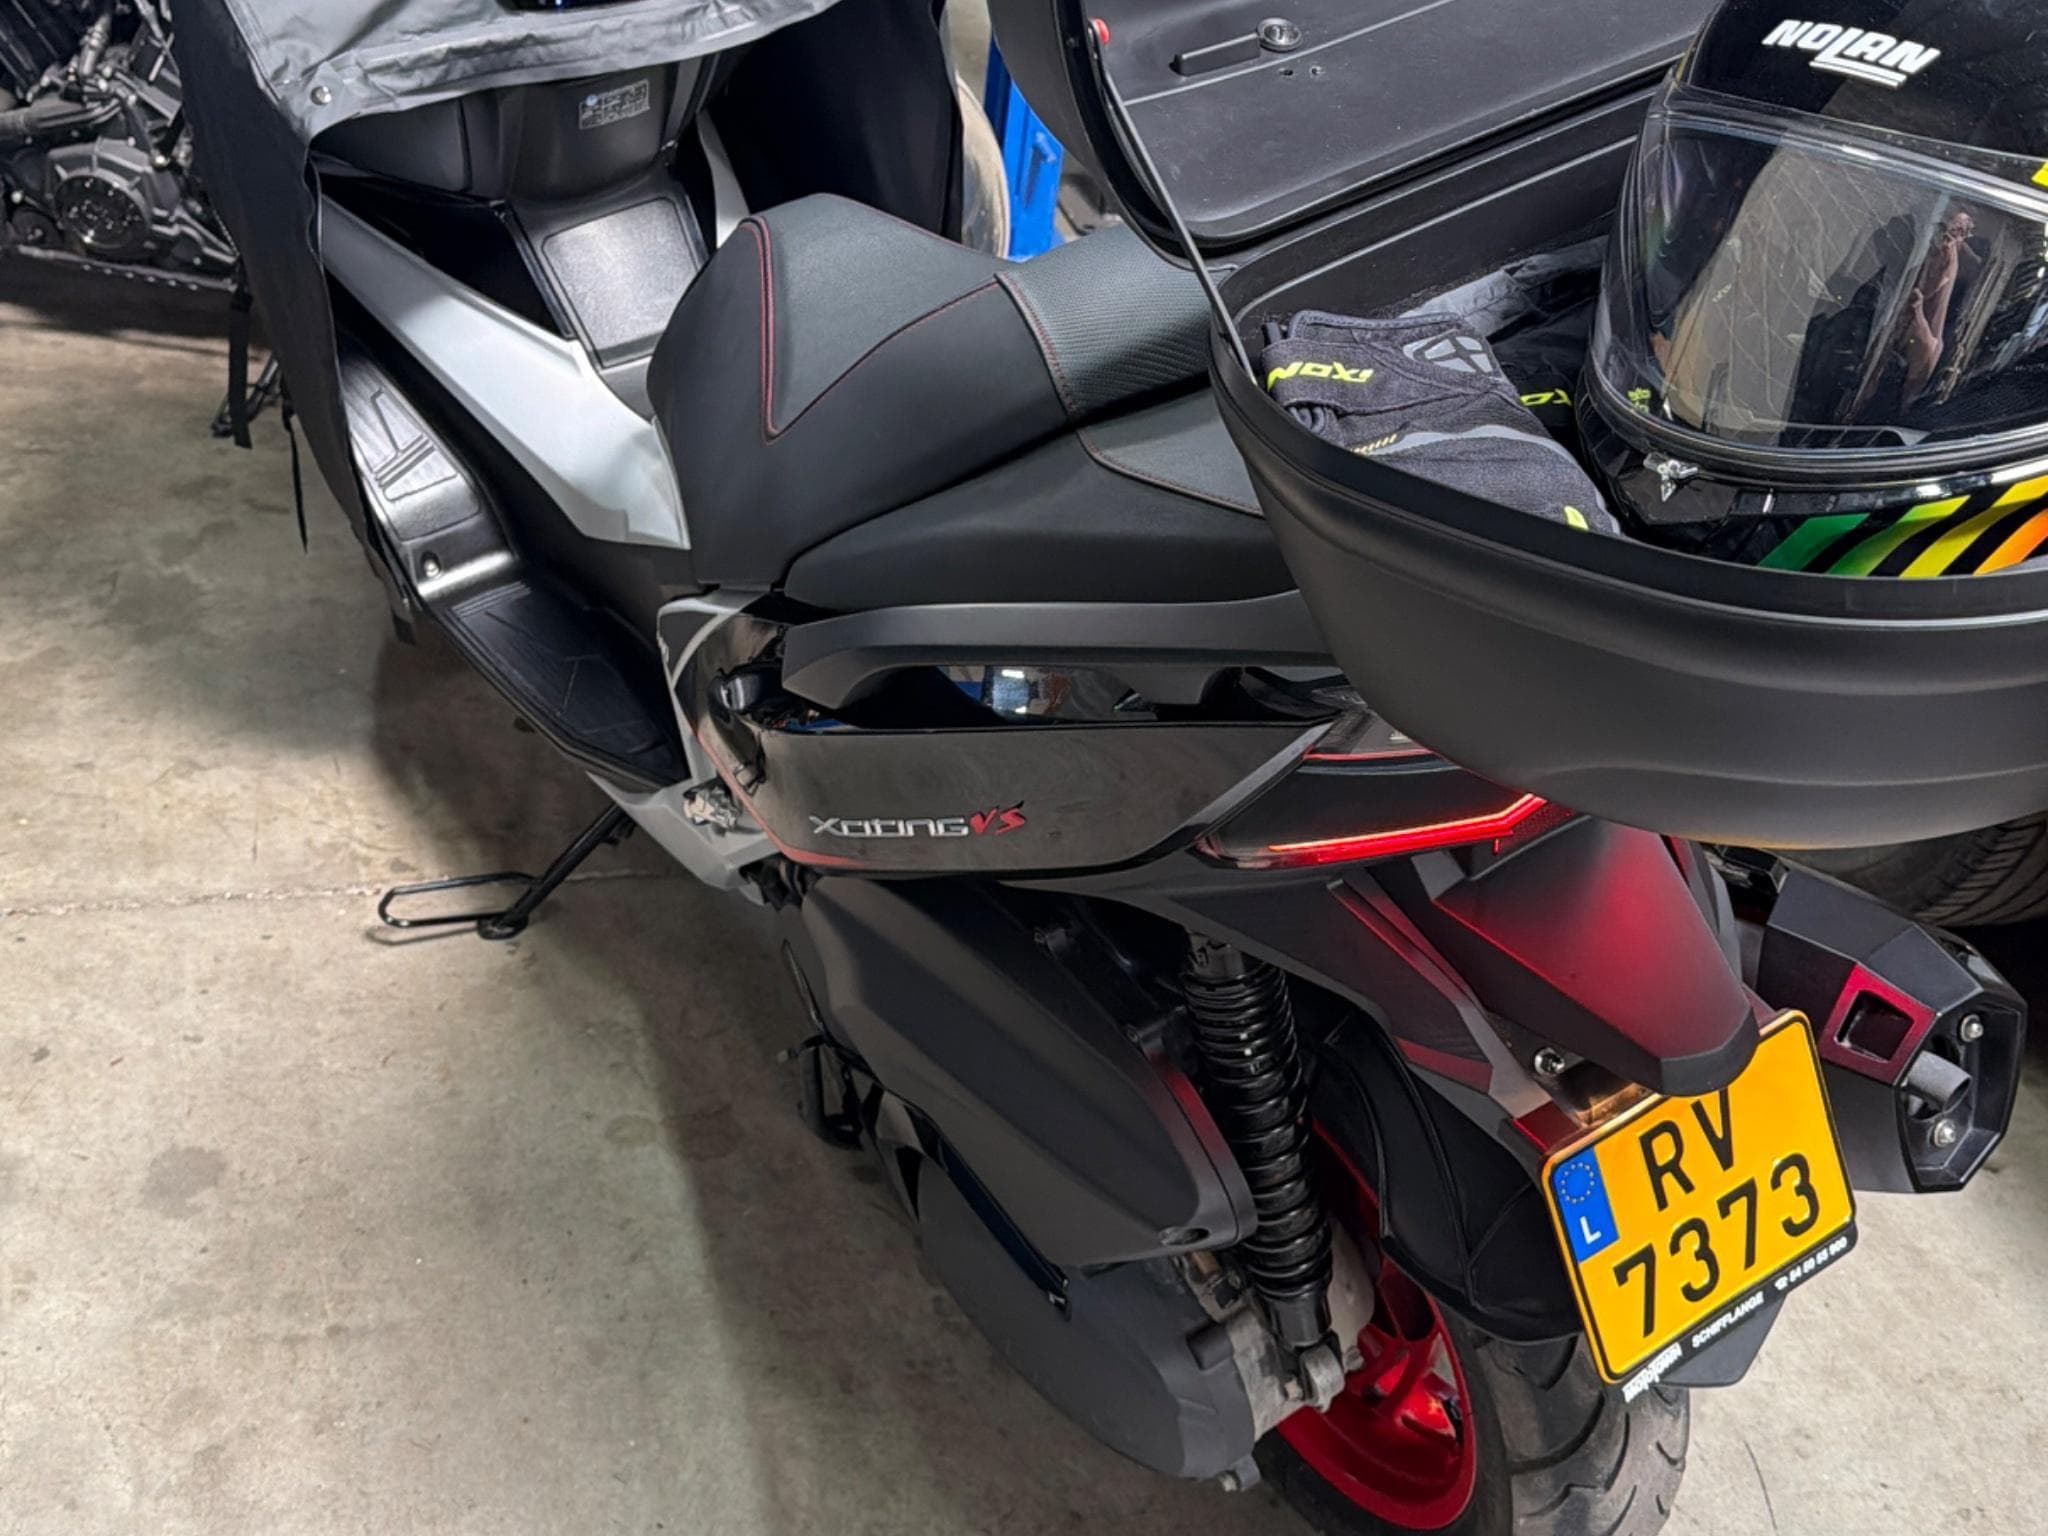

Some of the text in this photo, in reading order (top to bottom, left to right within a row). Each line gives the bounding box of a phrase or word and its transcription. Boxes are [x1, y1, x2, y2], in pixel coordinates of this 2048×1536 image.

[1762, 19, 1941, 84] NOLAN
[969, 800, 1026, 836] VS
[1638, 1088, 1734, 1212] RV
[1579, 1215, 1602, 1245] L
[1613, 1152, 1820, 1338] 7373
